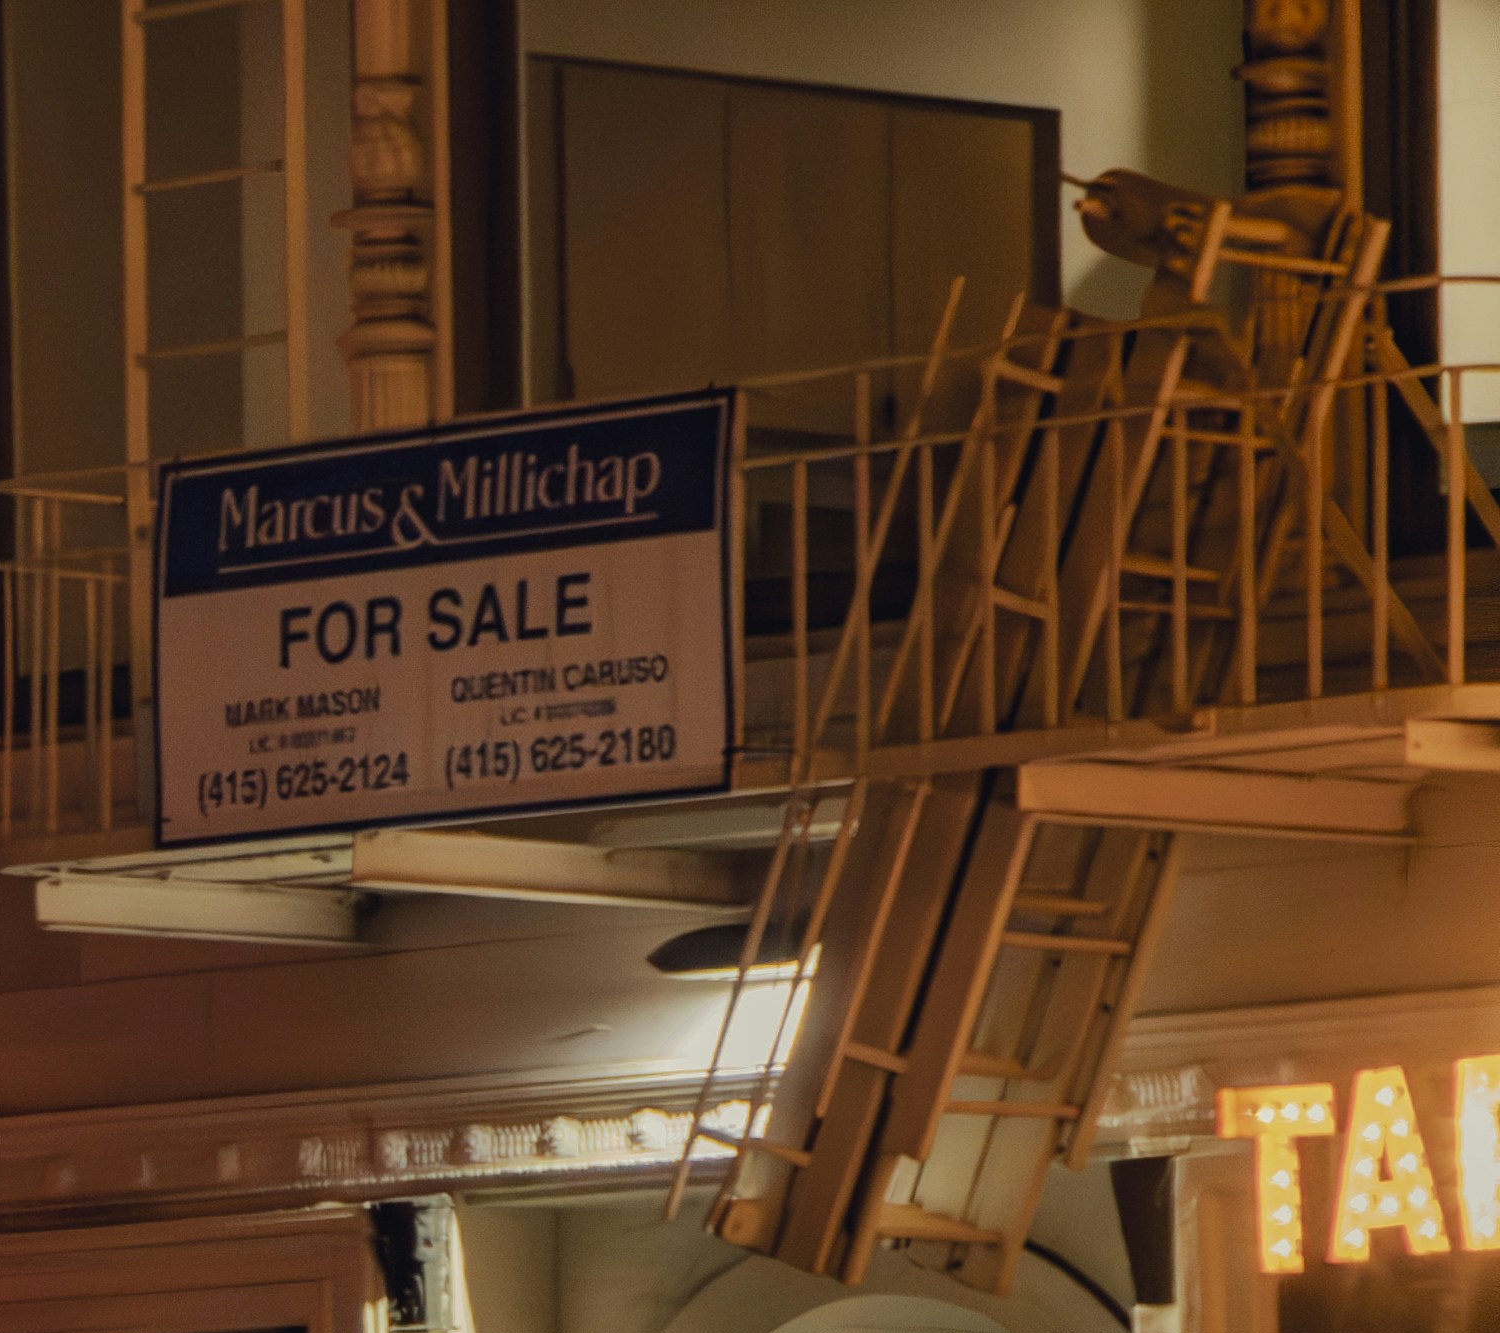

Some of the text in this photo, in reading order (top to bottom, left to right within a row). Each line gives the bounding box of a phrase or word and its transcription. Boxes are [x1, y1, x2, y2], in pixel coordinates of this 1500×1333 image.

[216, 482, 387, 555] Marcus
[436, 443, 662, 524] Millichap
[278, 571, 592, 670] FOR SALE
[225, 686, 381, 728] MARK MASON
[451, 652, 670, 703] QUENTIN CARUSO
[197, 751, 409, 817] (415) 625-2124
[445, 725, 677, 791] (415) 625-2180
